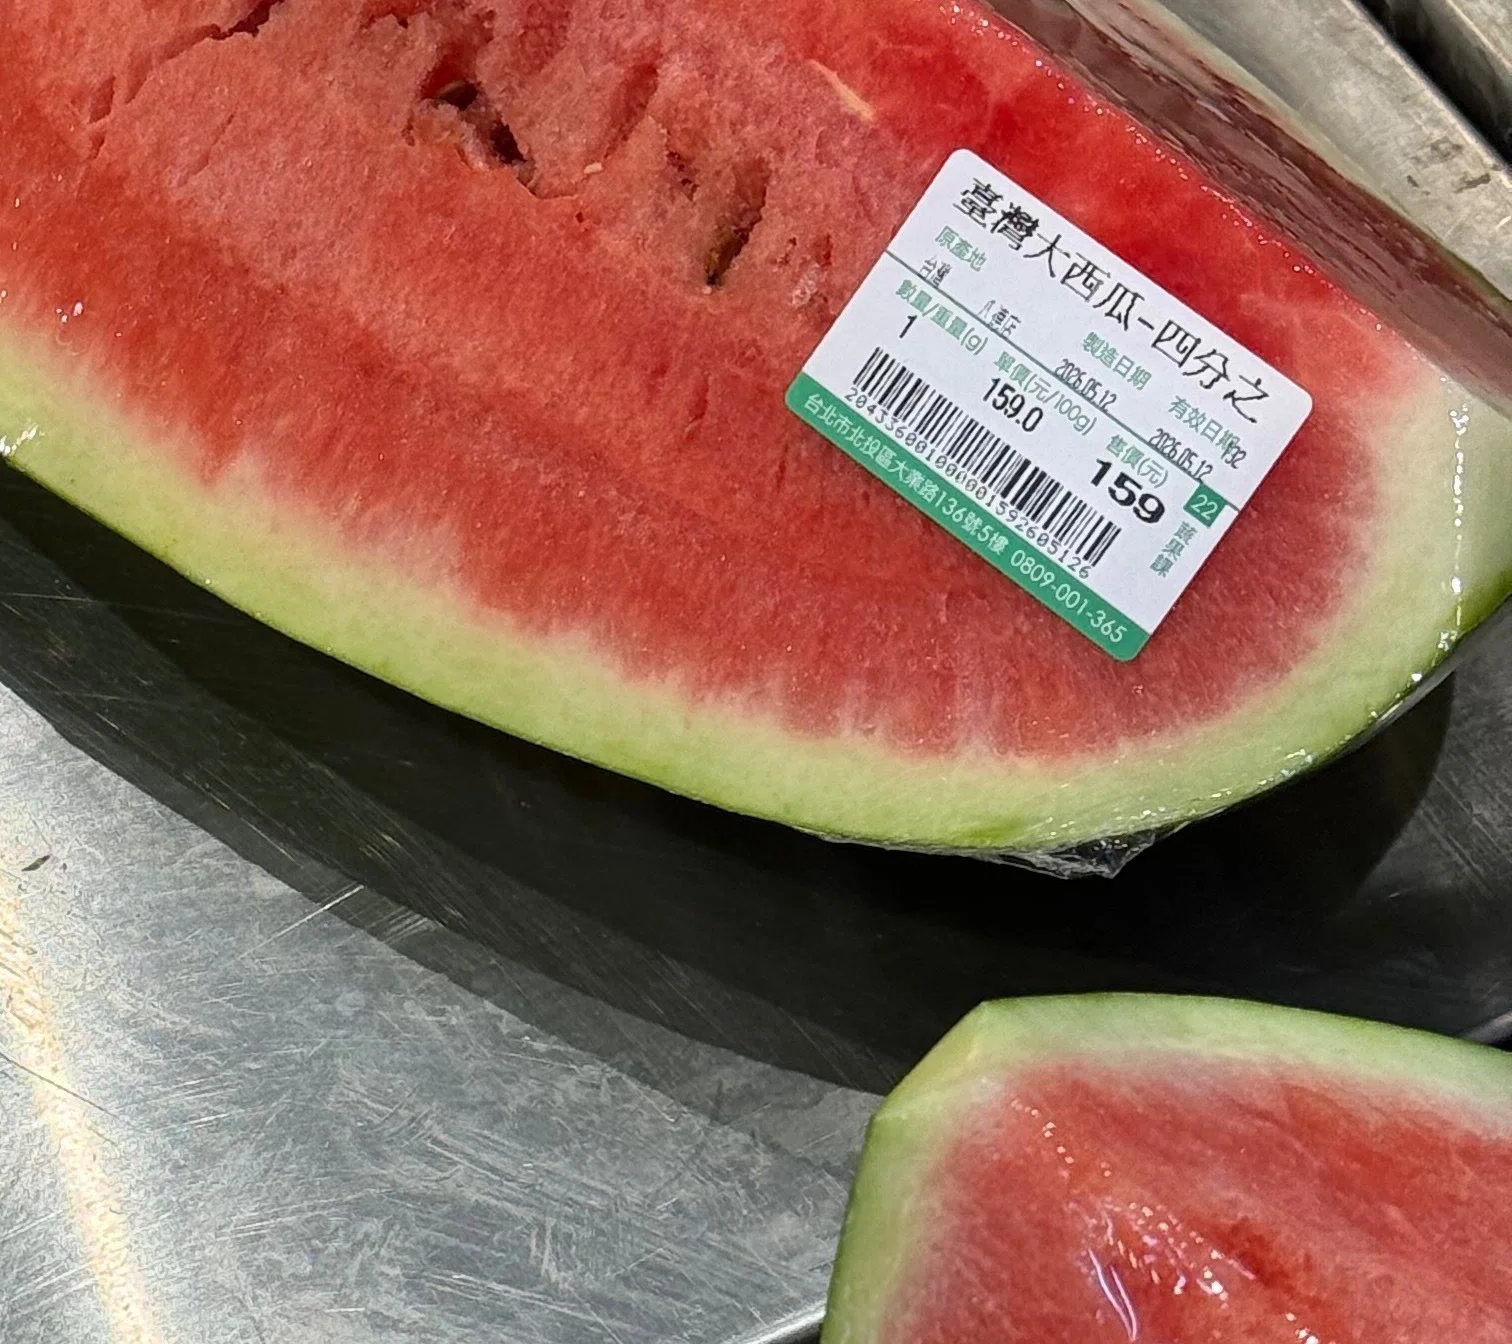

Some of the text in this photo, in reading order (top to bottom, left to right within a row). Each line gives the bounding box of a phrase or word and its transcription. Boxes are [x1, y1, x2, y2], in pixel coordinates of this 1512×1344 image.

[934, 225, 987, 273] 原產地
[898, 314, 918, 339] 1
[952, 177, 1270, 424] 臺灣大西瓜-四分之
[1052, 358, 1118, 413] 2026.05.12
[1081, 331, 1153, 391] 製造日期
[982, 377, 1044, 433] 159.0
[1105, 433, 1169, 490] 售價(元)
[1147, 427, 1215, 484] 2026.05.12
[1090, 458, 1166, 524] 159
[1190, 493, 1219, 521] 22
[1010, 549, 1128, 643] 0809-001-365
